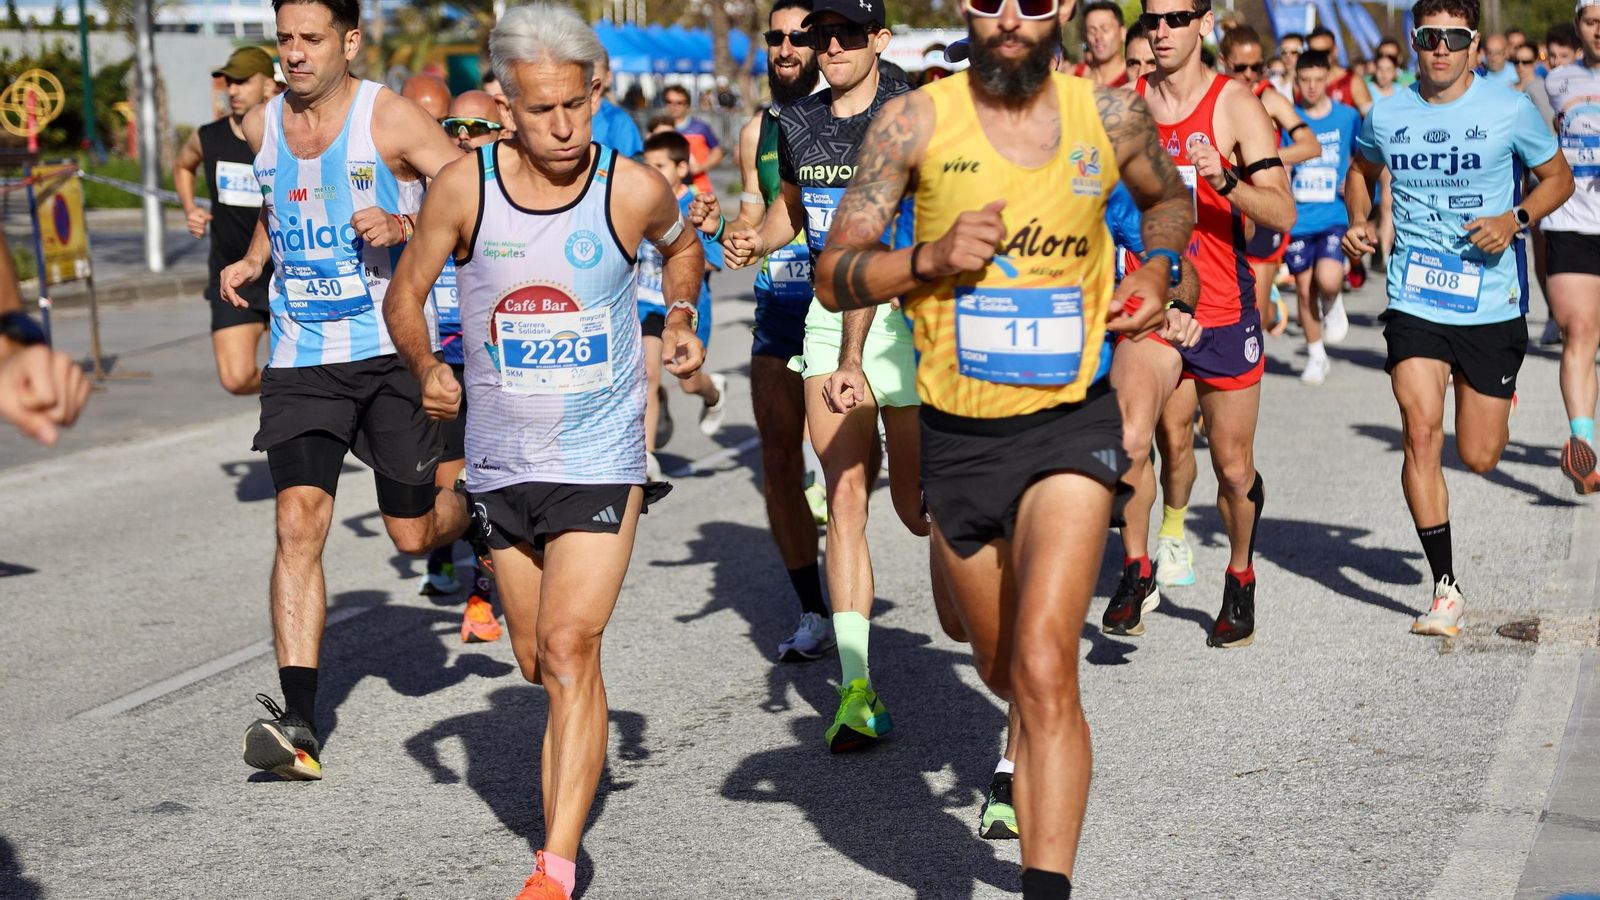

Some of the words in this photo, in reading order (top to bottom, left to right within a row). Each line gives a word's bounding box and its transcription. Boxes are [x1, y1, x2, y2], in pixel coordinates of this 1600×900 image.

[943, 156, 980, 173] vive
[1390, 146, 1482, 175] nerja
[256, 168, 276, 178] vive
[314, 185, 335, 193] metro
[1406, 179, 1470, 188] ATLETISMO
[1000, 217, 1090, 258] Álora
[482, 247, 526, 260] deportes
[1425, 269, 1460, 290] 608
[306, 279, 342, 297] 450
[290, 301, 308, 309] 10KM
[504, 298, 537, 312] Café
[542, 298, 568, 312] Bar
[580, 312, 606, 322] mayoral
[1004, 319, 1039, 348] 11
[520, 337, 592, 365] 2226
[505, 369, 524, 378] 5KM
